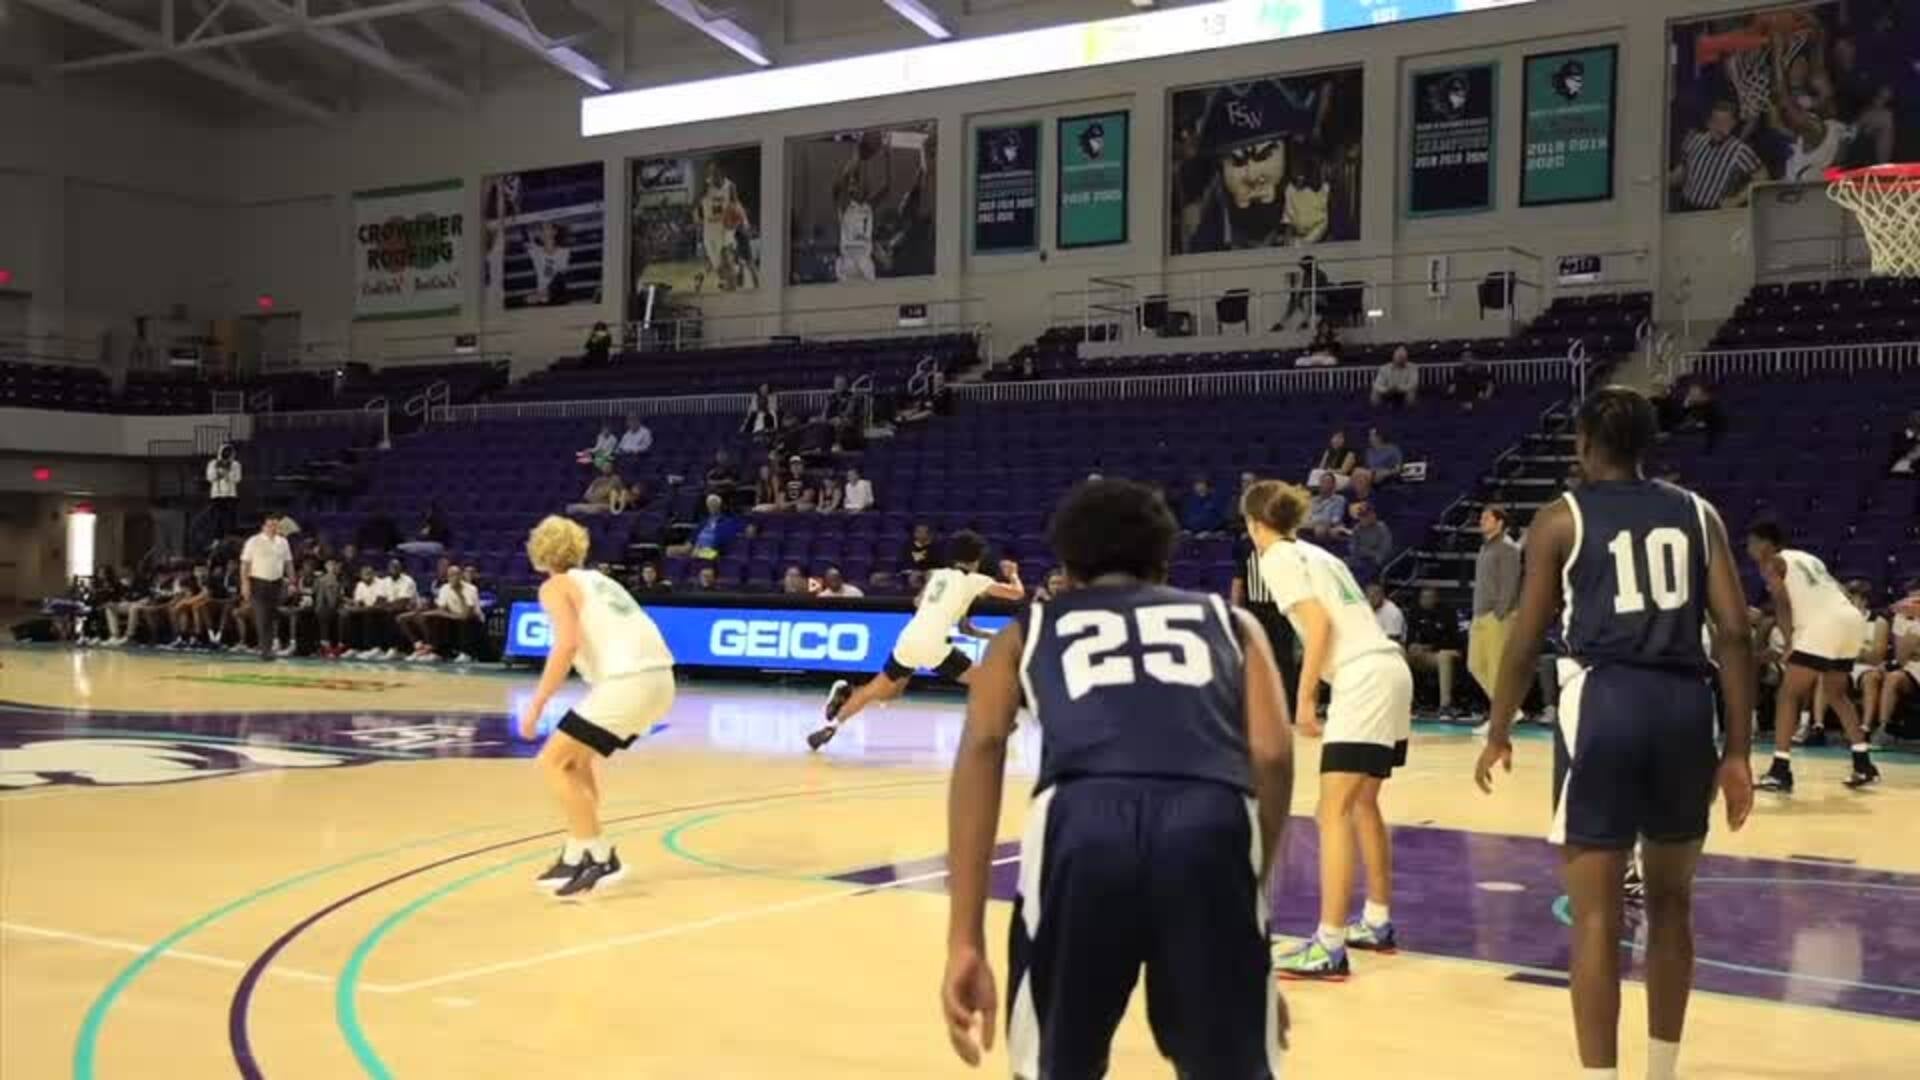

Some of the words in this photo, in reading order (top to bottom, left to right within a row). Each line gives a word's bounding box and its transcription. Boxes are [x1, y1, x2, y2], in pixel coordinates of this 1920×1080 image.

[1228, 101, 1262, 128] FSW
[368, 241, 453, 270] ROOFING
[1608, 527, 1689, 614] 10
[710, 619, 869, 661] GEICO
[1055, 603, 1214, 700] 25
